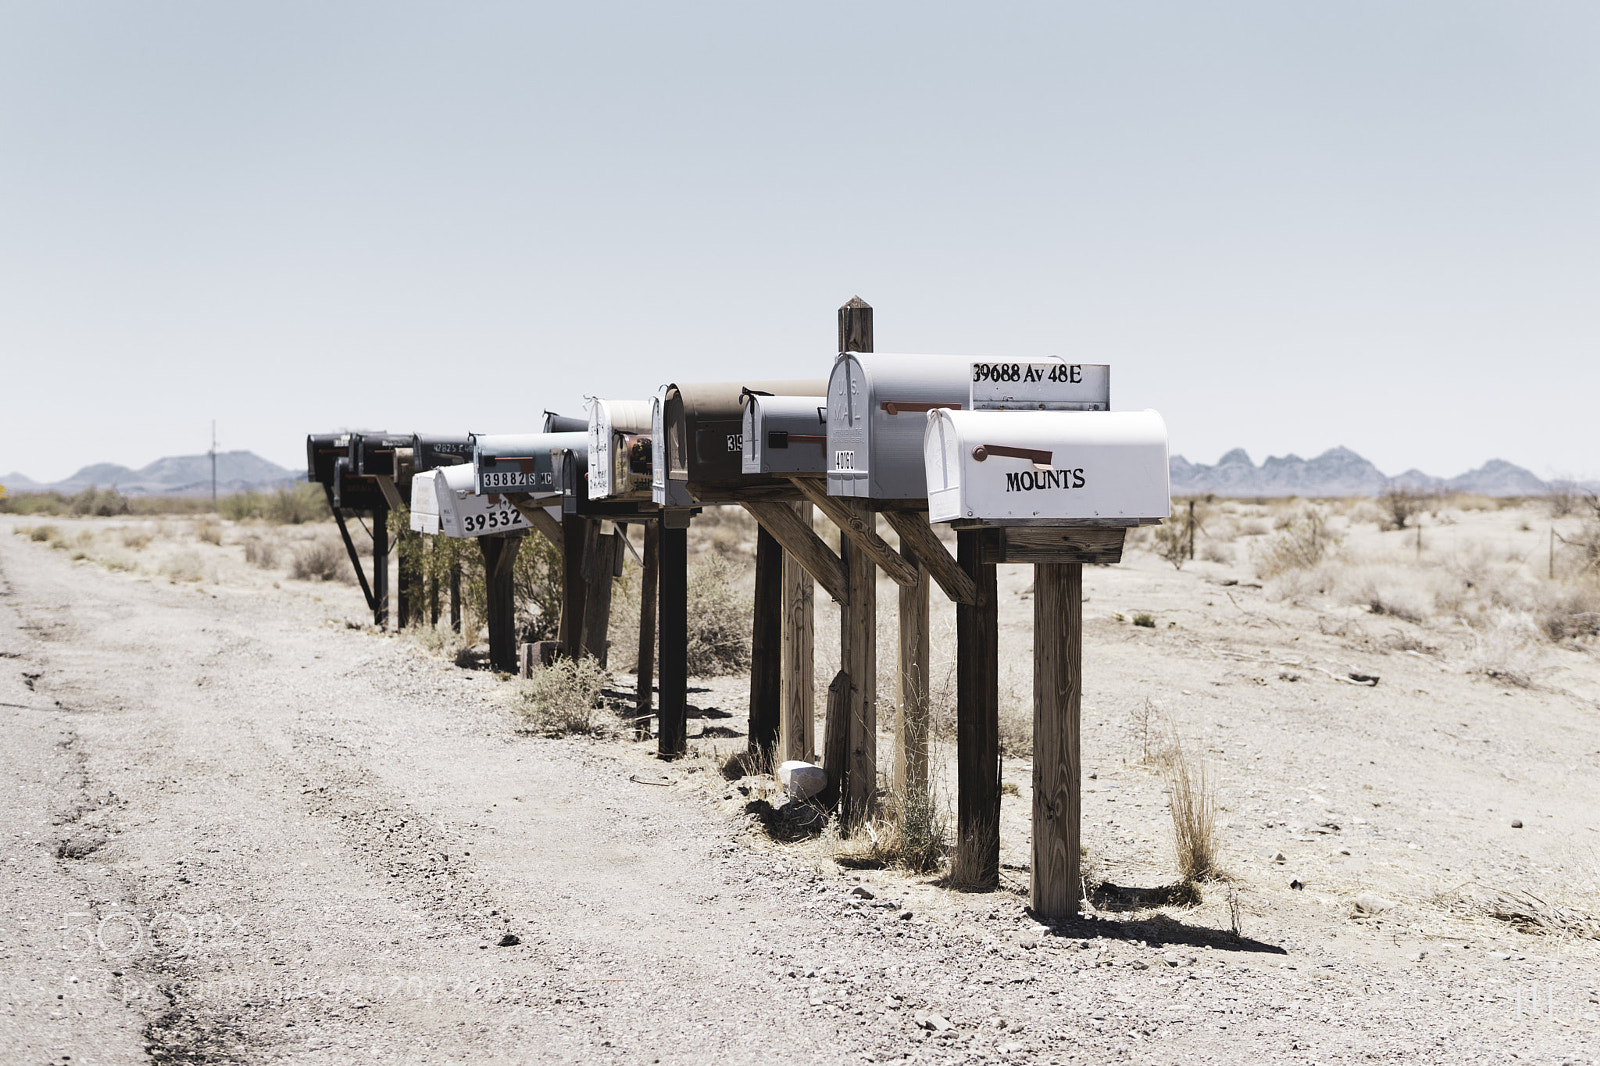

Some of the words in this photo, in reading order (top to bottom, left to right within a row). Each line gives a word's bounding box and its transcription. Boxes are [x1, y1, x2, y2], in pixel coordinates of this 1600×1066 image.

[973, 363, 1021, 383] 39688
[1023, 363, 1045, 383] Av
[484, 472, 526, 487] 39882
[529, 472, 536, 485] S
[1006, 468, 1086, 492] MOUNTS
[464, 509, 523, 533] 39532
